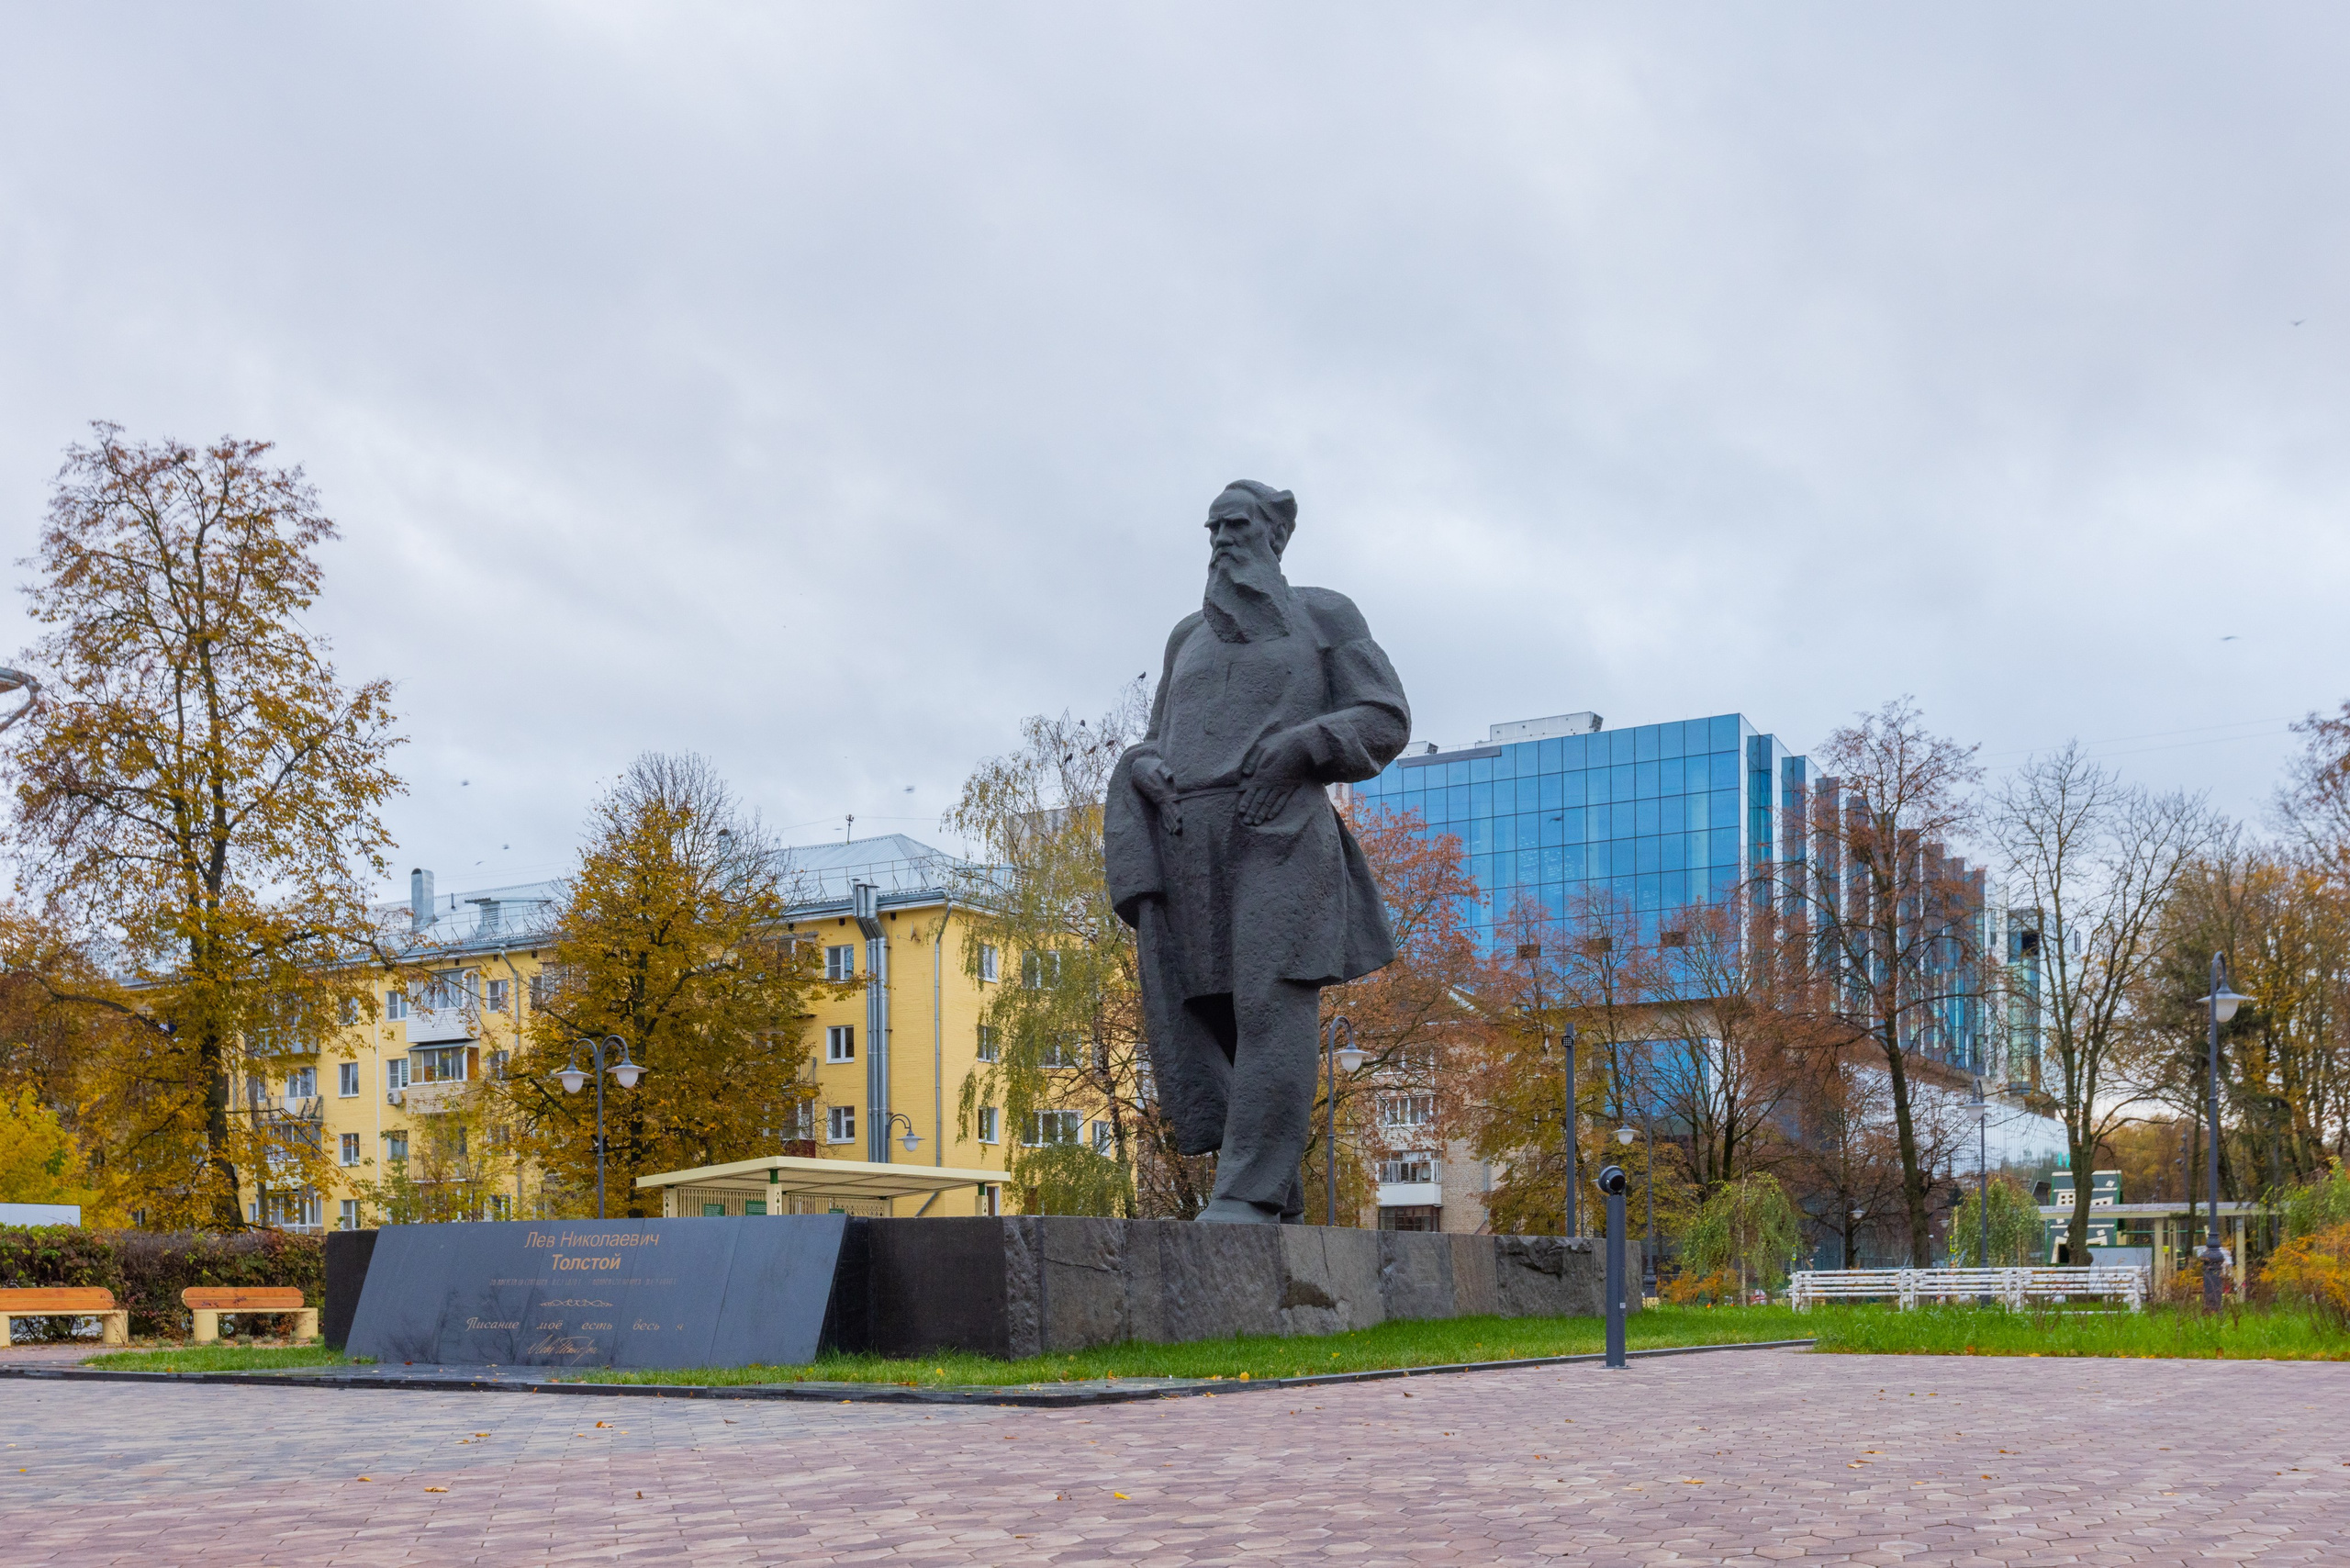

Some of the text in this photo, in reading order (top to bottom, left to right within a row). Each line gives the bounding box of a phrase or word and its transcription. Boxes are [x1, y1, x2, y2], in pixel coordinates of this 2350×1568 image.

[524, 1230, 660, 1248] Лев Николаевич
[552, 1252, 621, 1271] Толстой
[464, 1316, 685, 1332] Писание моё есть весь я
